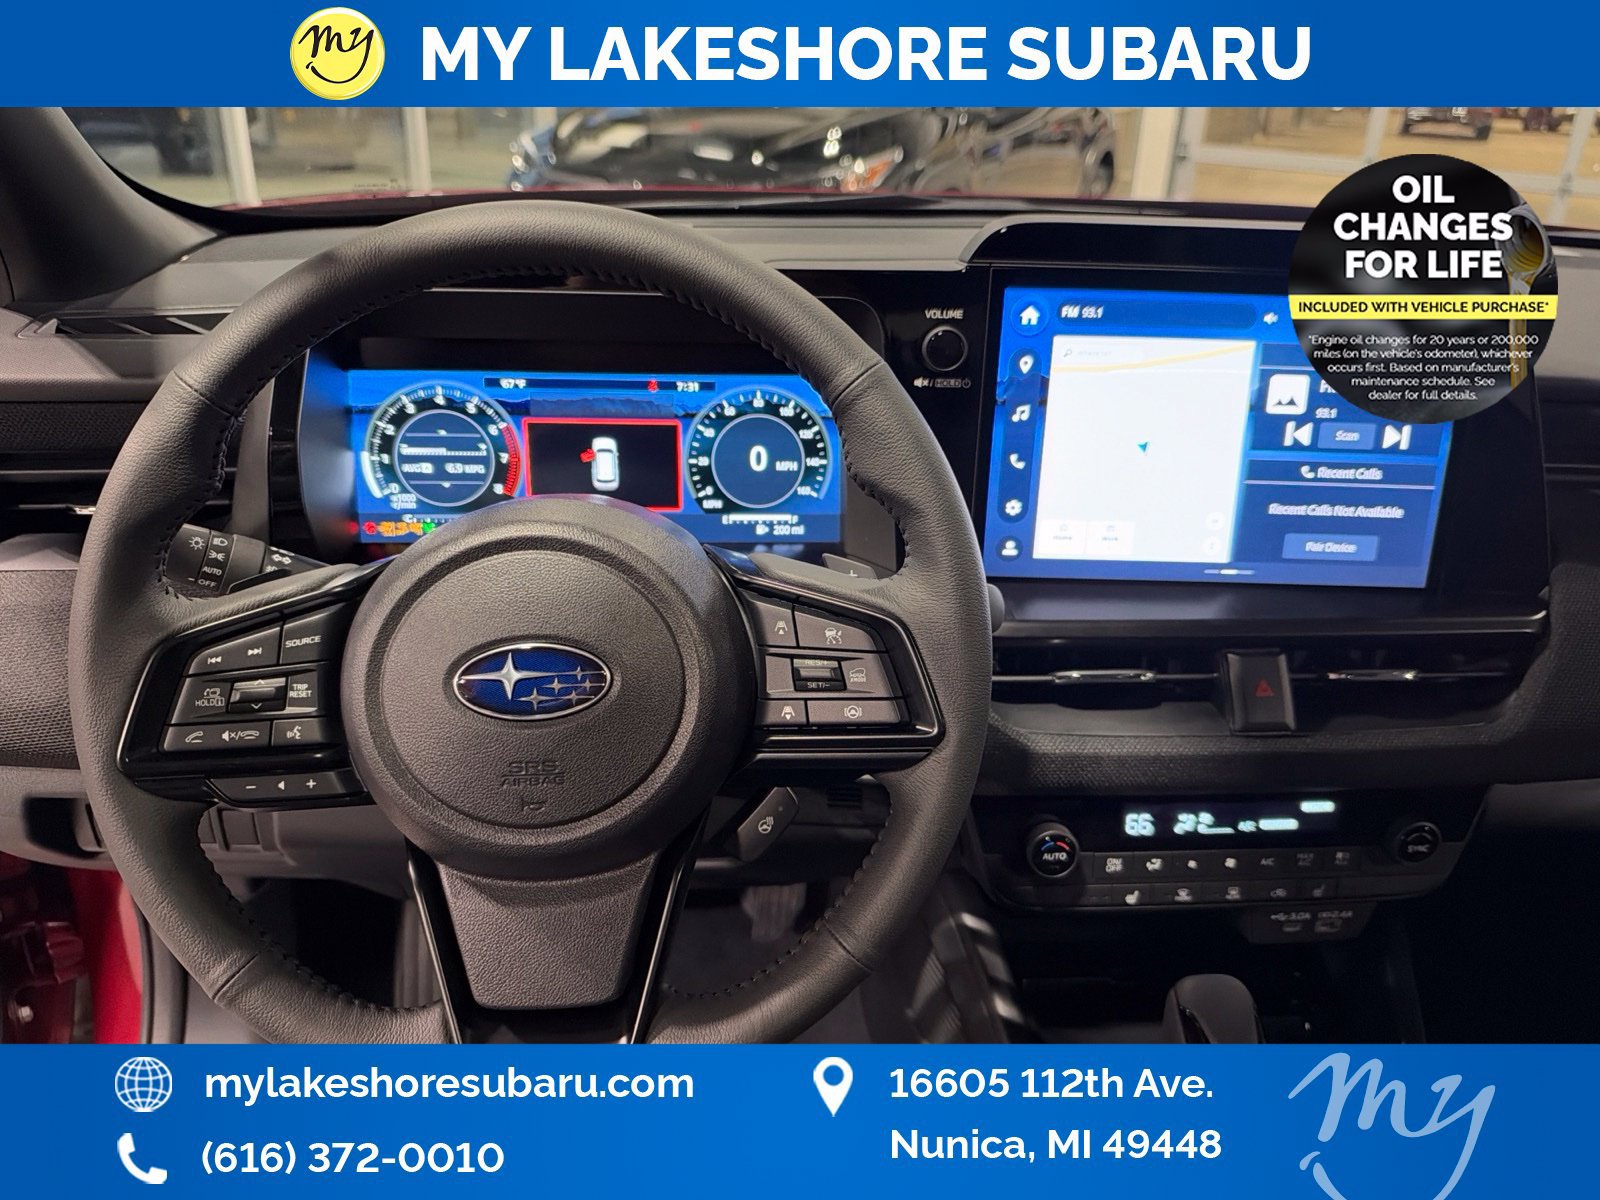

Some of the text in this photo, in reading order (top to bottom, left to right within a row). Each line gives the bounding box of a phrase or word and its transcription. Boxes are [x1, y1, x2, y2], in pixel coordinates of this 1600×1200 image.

[925, 308, 963, 319] VOLUME
[1061, 305, 1103, 319] FM 93.1
[1335, 430, 1360, 441] Scan
[749, 445, 768, 472] 0
[1317, 467, 1383, 480] Recent Calls
[1268, 503, 1405, 519] Recent Calls Not Available
[202, 566, 223, 577] AUTO
[198, 579, 217, 588] OFF
[285, 635, 321, 648] SOURCE
[293, 683, 309, 691] TRIP
[290, 690, 313, 698] RESET
[1125, 812, 1155, 836] 66
[1042, 852, 1067, 861] AUTO
